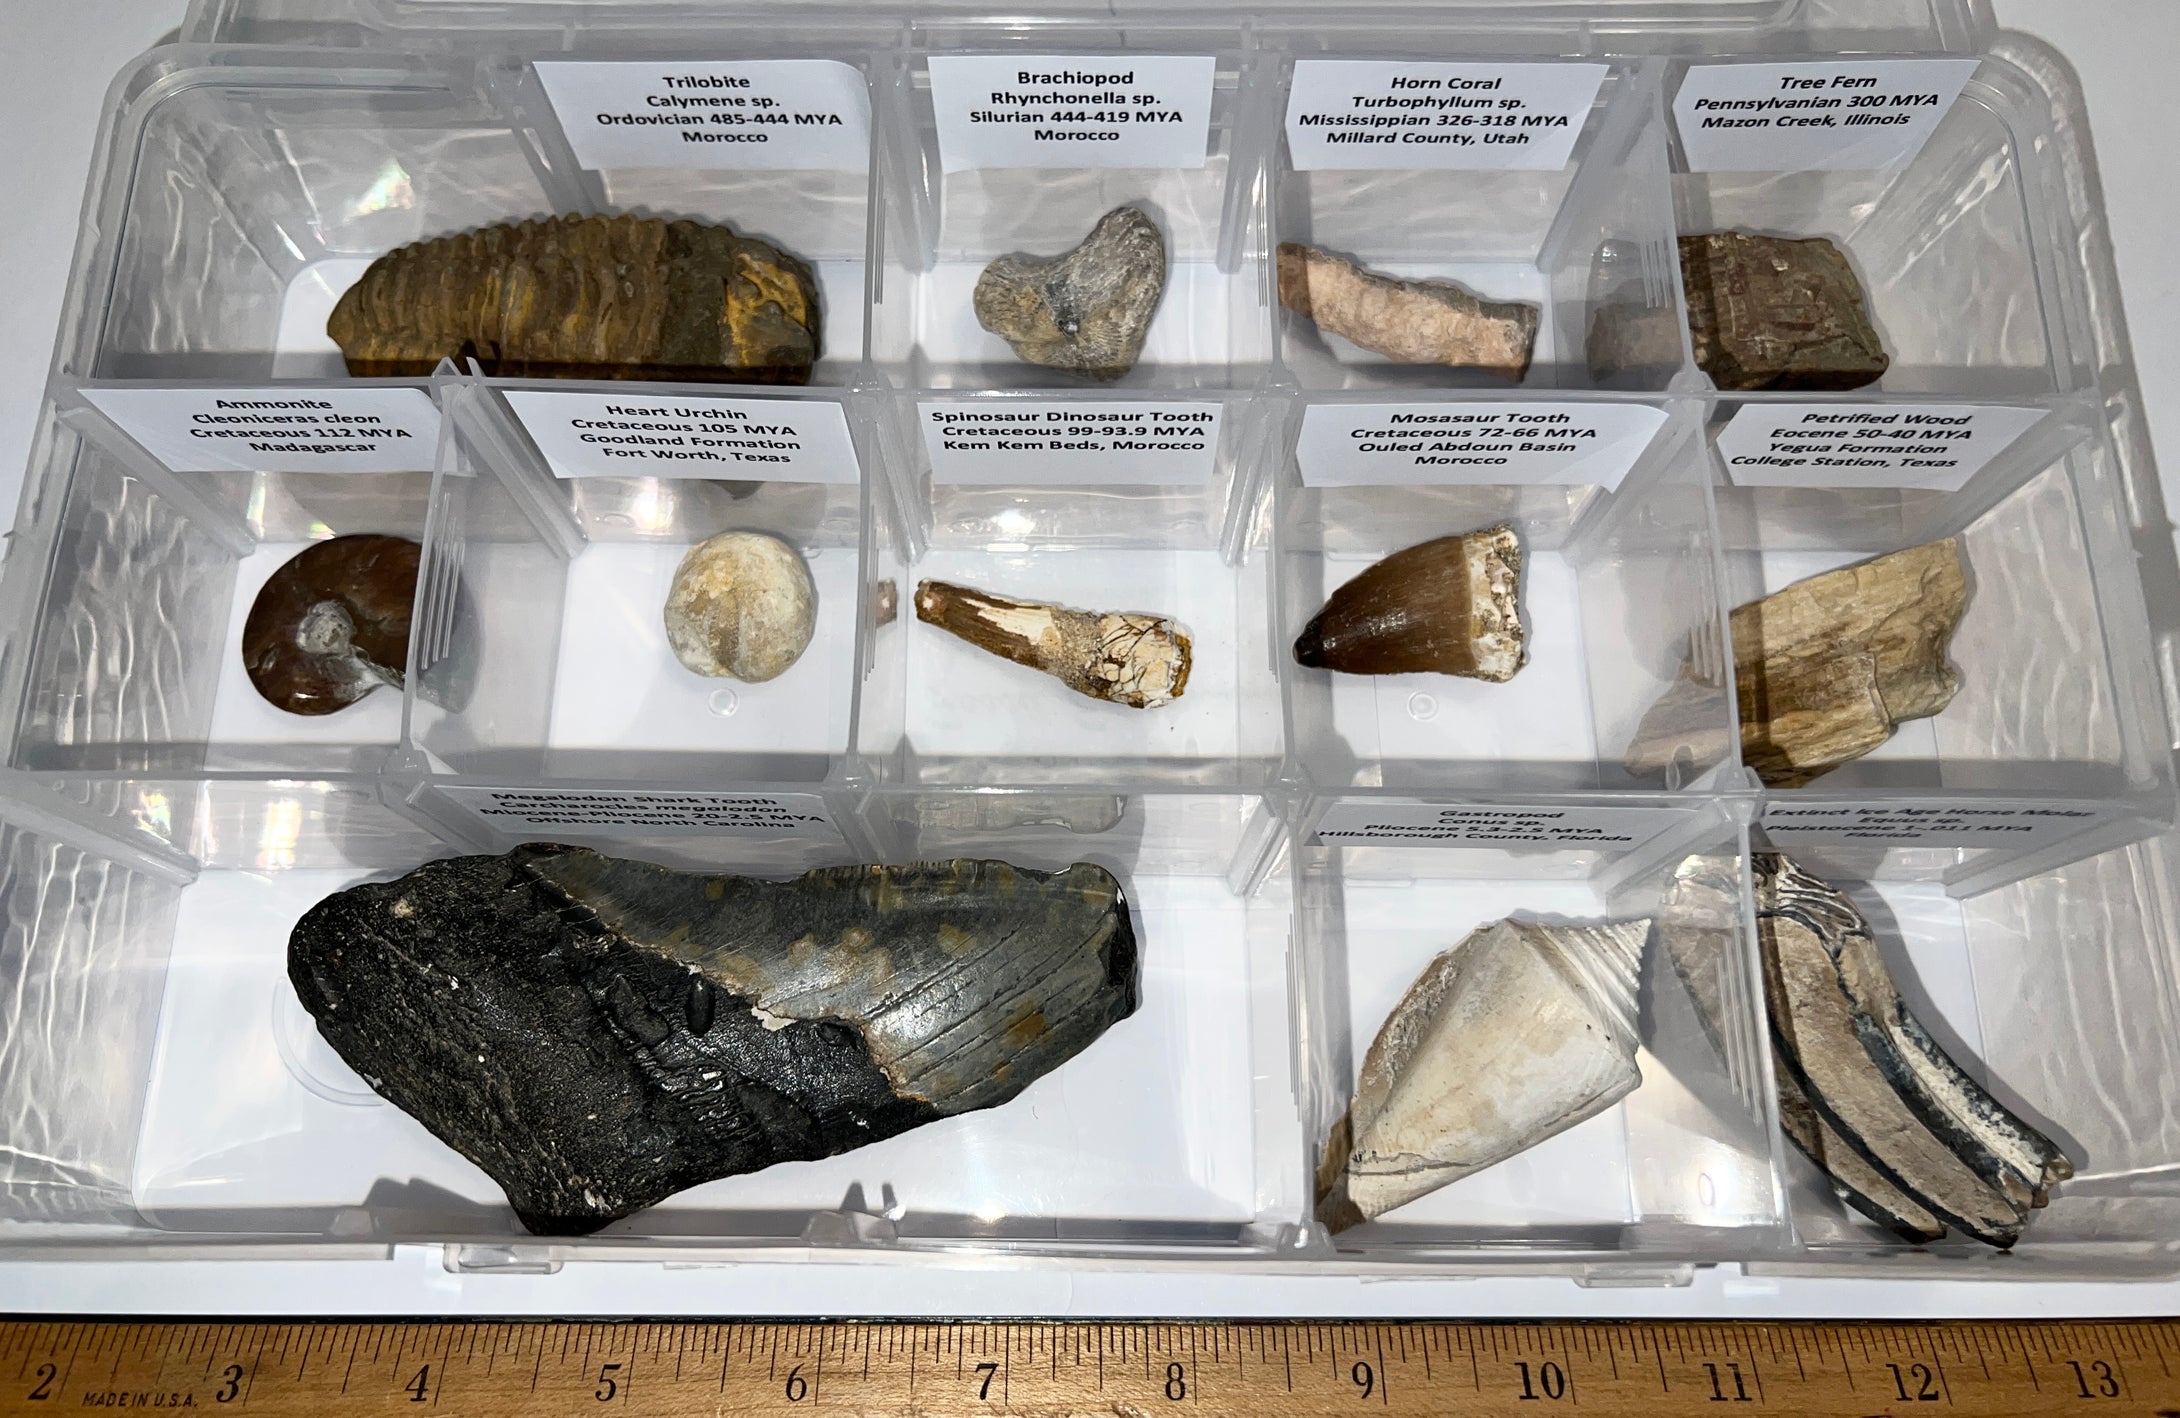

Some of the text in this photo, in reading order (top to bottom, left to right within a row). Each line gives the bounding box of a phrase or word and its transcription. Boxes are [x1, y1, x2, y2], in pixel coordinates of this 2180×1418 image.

[662, 77, 750, 88] Trilobite
[1018, 71, 1134, 87] Brachiopod
[1391, 78, 1502, 90] Horn Coral
[1780, 76, 1877, 89] Tree Fern
[646, 96, 780, 109] Calymene sp.
[991, 92, 1161, 106] Rhynchonella sp.
[1353, 97, 1526, 110] Turbophyllum sp.
[1695, 95, 1938, 112] Pennsylvanian 300 MYA
[596, 114, 842, 125] Ordovician 485-444 MYA
[970, 112, 1183, 123] Silurian 444-419 MYA
[1299, 115, 1568, 128] Mississippian 326-318 MYA
[1701, 114, 1911, 128] Mazon Creek, Illinois
[682, 132, 768, 142] Morocco
[1034, 131, 1120, 141] Morocco
[1326, 133, 1529, 146] Millard County, Utah
[216, 400, 332, 409] Ammonite
[606, 406, 747, 419] Heart Urchin
[932, 412, 1213, 424] Spinosaur Dinosaur Tooth
[1390, 413, 1570, 423] Mosasaur Tooth
[192, 415, 381, 424] Cleoniceras cleon
[1801, 414, 1973, 425] Petrified Wood
[571, 419, 797, 436] Cretaceous 105 MYA
[942, 427, 1204, 436] Cretaceous 99-93.9 MYA
[1351, 428, 1596, 438] Cretaceous 72-66 MYA
[190, 429, 412, 438] Cretaceous 112 MYA
[1771, 429, 1972, 439] Eocene 50-40 MYA
[580, 433, 801, 449] Goodland Formation
[944, 441, 1204, 451] Kem Kem Beds, Morocco
[249, 443, 376, 454] Madagascar
[1359, 442, 1576, 452] Ouled Abdoun Basin
[1770, 444, 1948, 454] Yegua Formation
[603, 449, 791, 463] Fort Worth, Texas
[1415, 456, 1507, 465] Morocco
[1730, 457, 1957, 467] College Station, Texas
[480, 809, 685, 818] Miocene-Pliocene
[28, 1361, 2120, 1402] 2 3 4 5 6 7 8 9 10 11 12 13
[82, 1392, 199, 1407] MADE IN U.S.A.
